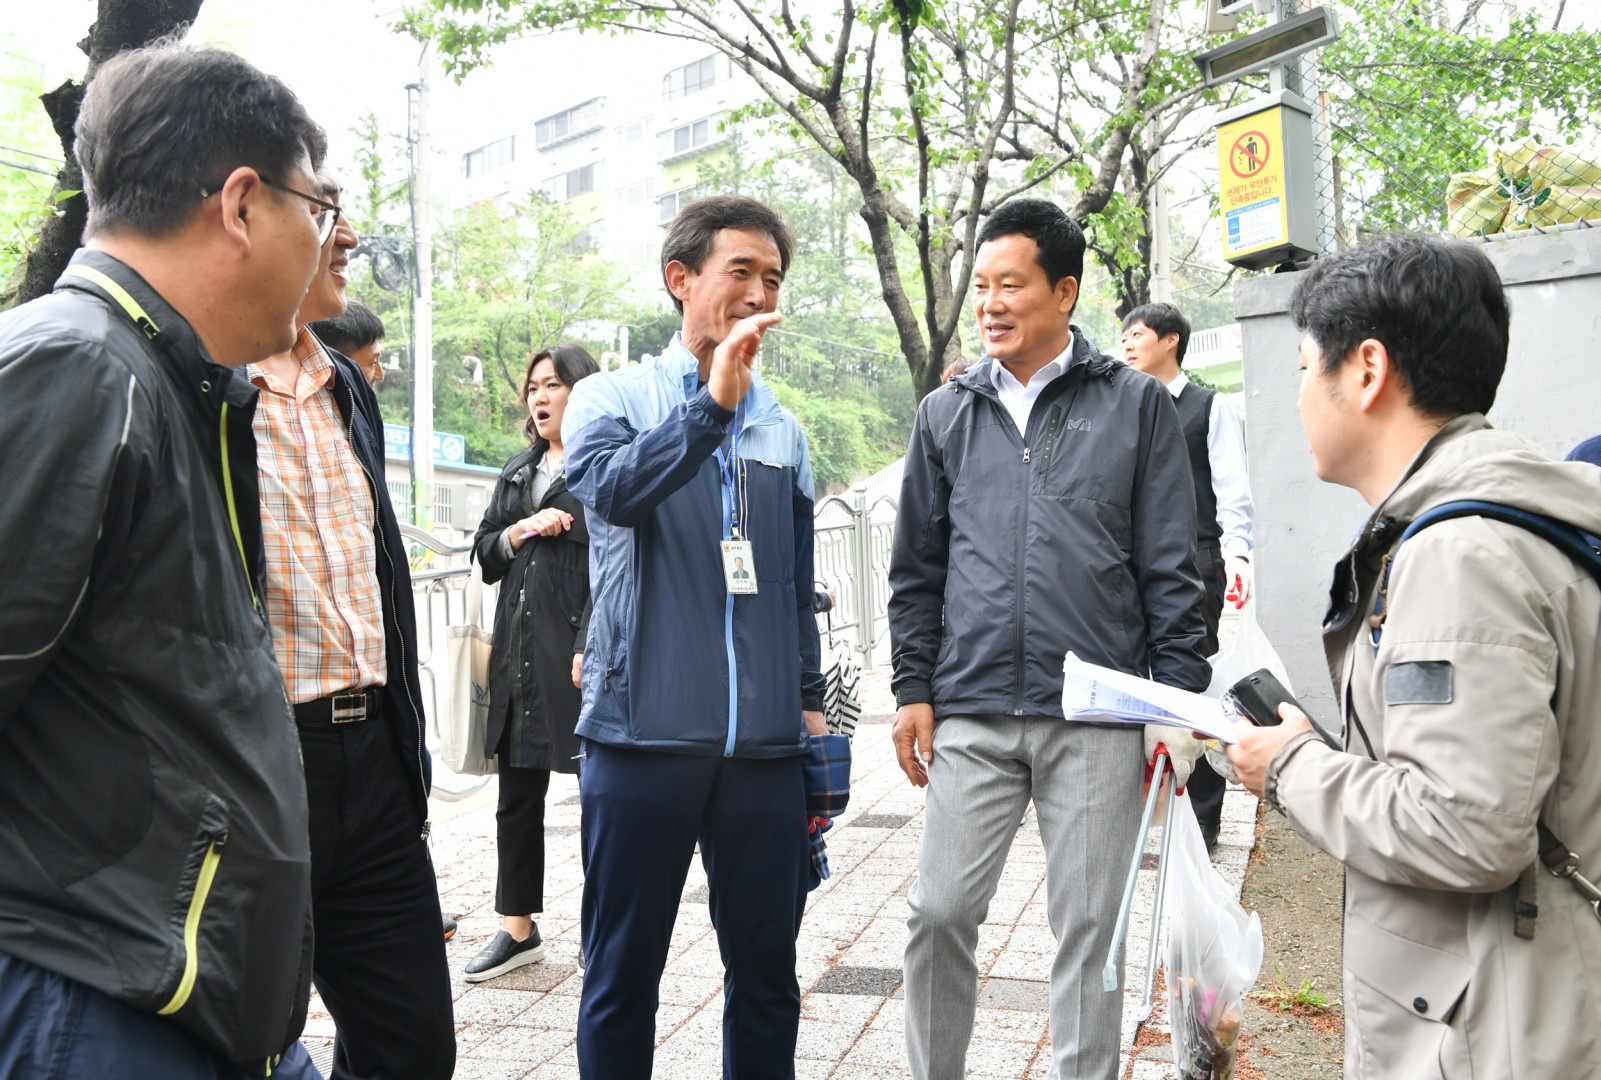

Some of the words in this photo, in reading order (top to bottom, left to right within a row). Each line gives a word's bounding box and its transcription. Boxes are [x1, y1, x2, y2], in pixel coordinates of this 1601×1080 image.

[1227, 183, 1247, 197] 쓰레기
[1249, 174, 1277, 190] 무단투기
[1230, 185, 1274, 206] 단속중입니다.
